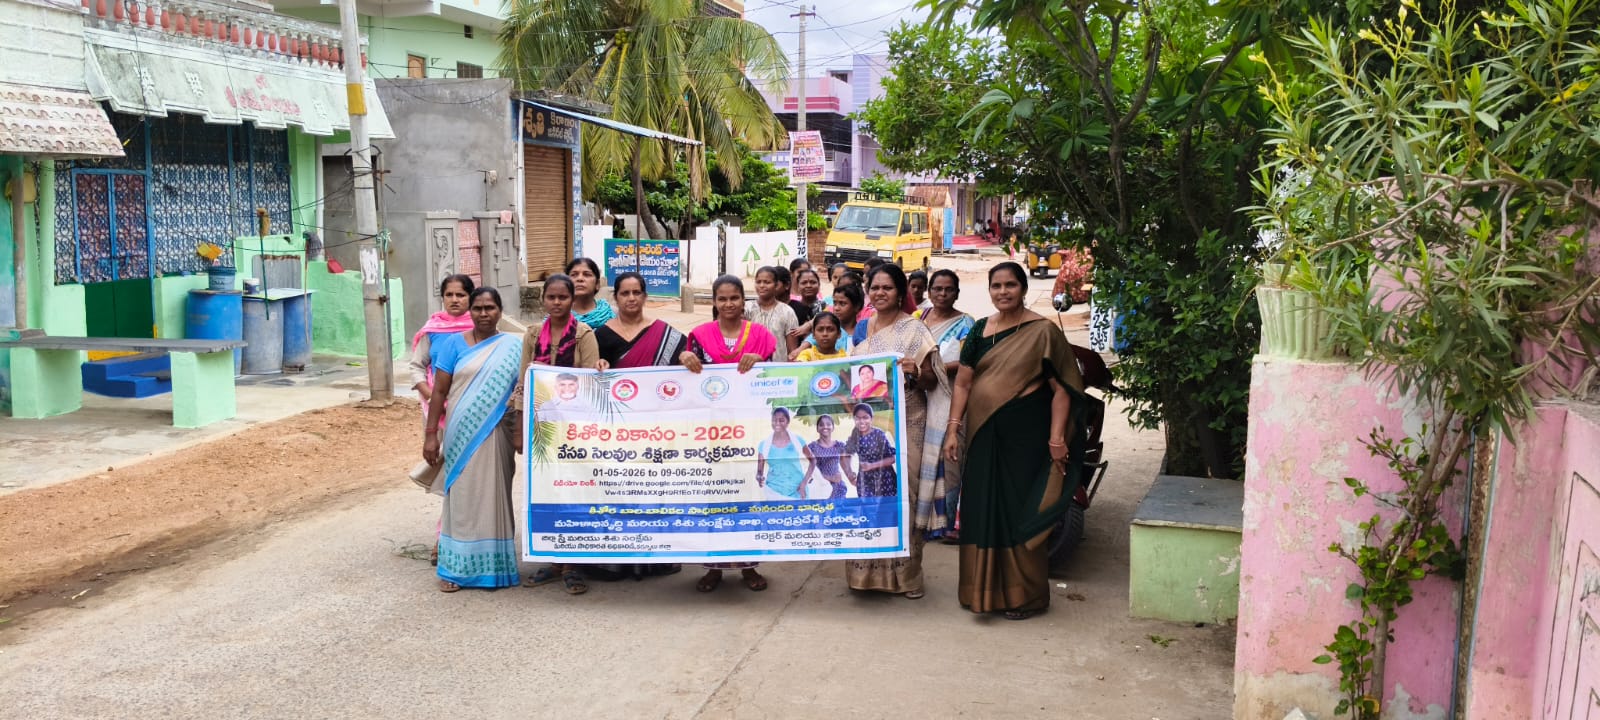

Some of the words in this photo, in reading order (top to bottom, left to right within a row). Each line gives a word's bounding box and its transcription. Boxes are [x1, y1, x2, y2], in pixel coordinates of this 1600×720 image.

[566, 423, 612, 441] కిశోరి
[616, 426, 676, 441] వికాసం
[694, 425, 746, 441] 2026
[557, 443, 588, 460] వేసవి
[591, 446, 638, 463] సెలవుల
[641, 446, 680, 464] శిక్షణా
[683, 445, 756, 464] కార్యక్రమాలు
[592, 467, 646, 477] 01-05-2026
[648, 468, 658, 477] to
[660, 467, 713, 477] 09-06-2026
